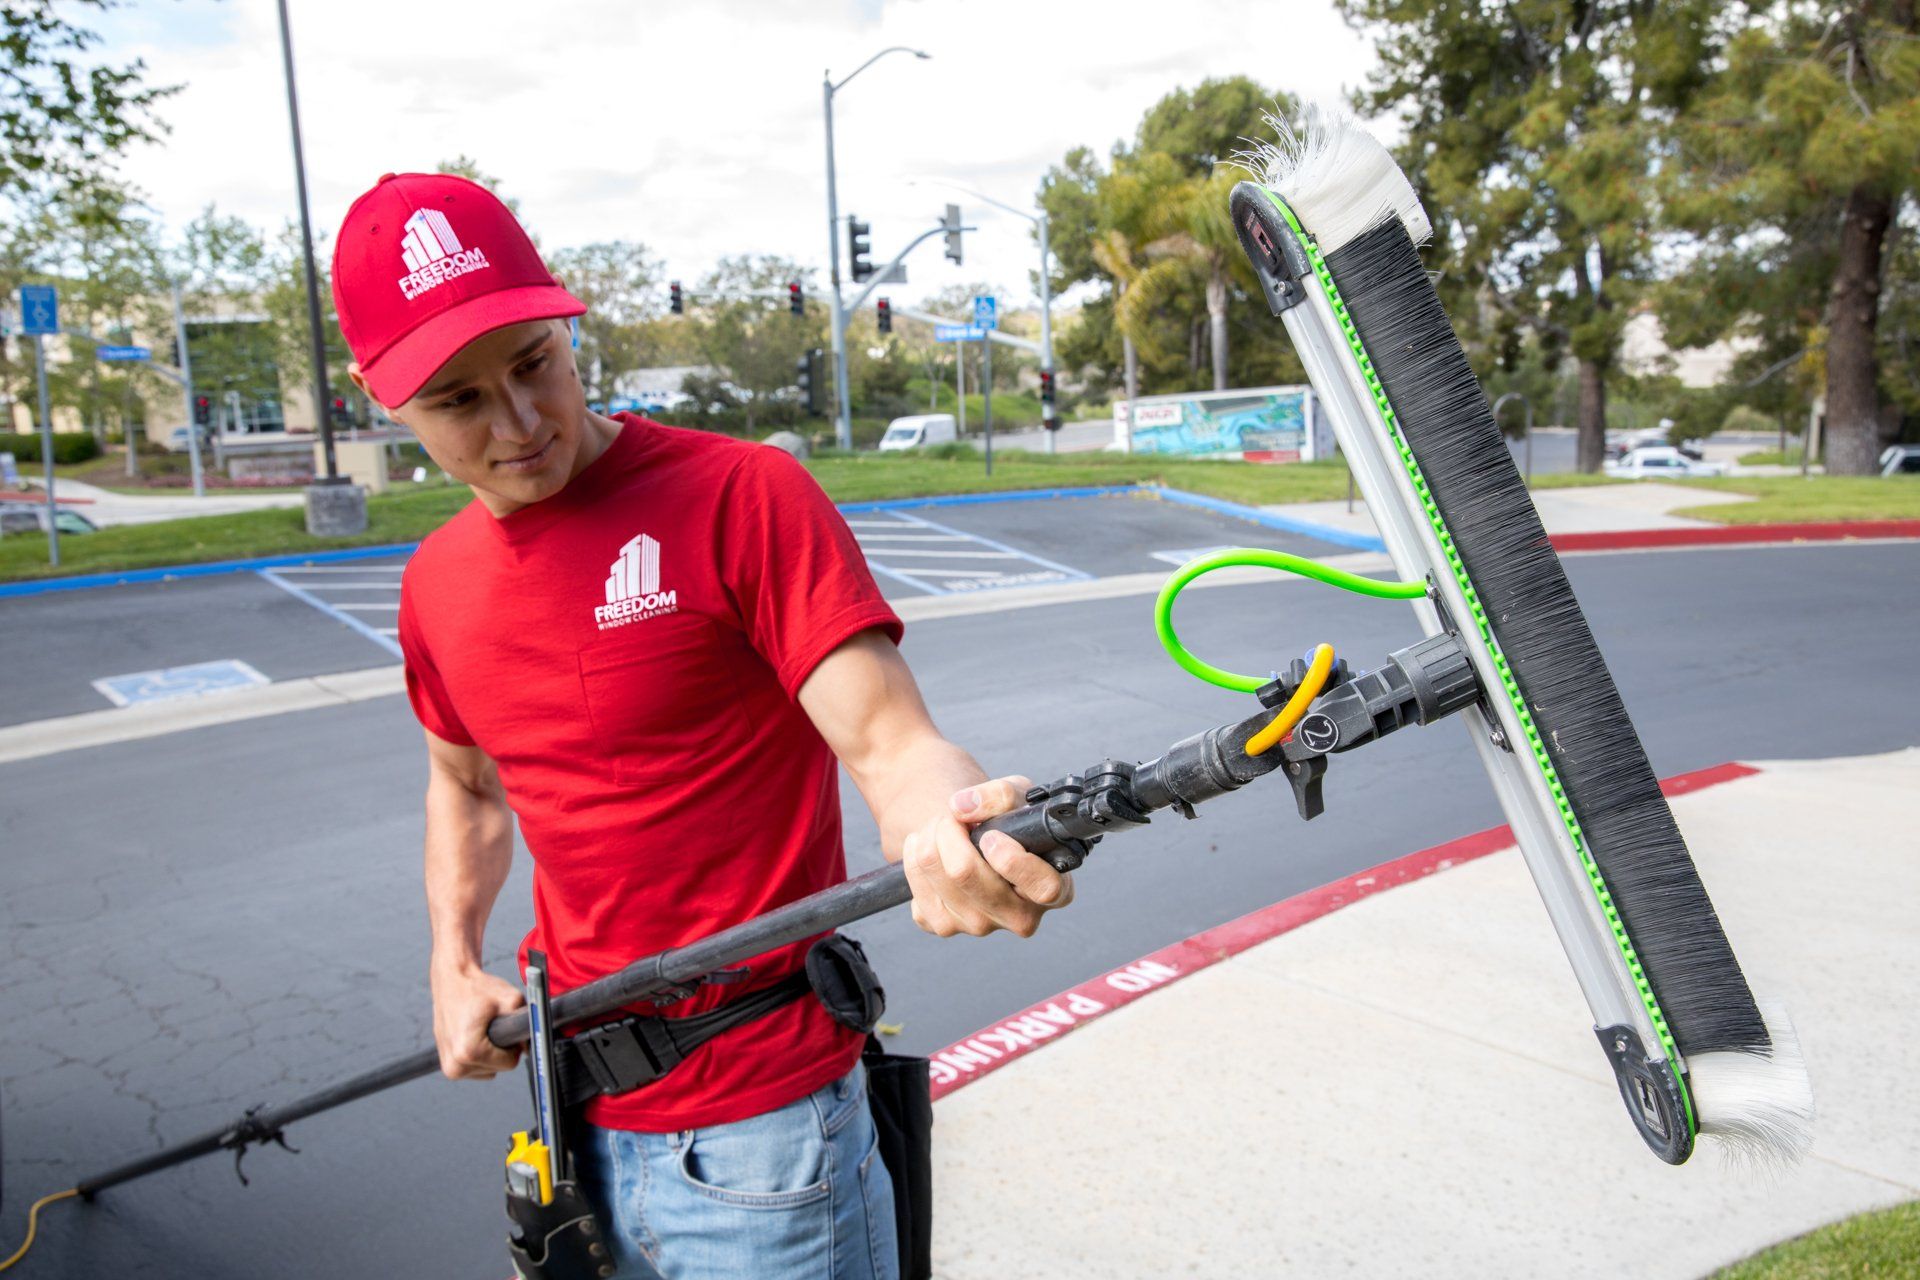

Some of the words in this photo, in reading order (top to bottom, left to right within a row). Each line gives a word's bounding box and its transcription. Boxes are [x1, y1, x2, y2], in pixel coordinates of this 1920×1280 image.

[398, 247, 486, 292] FREEDOM
[404, 274, 444, 300] WINDOW
[444, 261, 490, 280] CLEANING
[594, 590, 677, 622] FREEDOM
[598, 617, 632, 630] WINDOW
[632, 606, 678, 621] CLEANING
[1106, 960, 1178, 992] NO
[929, 993, 1104, 1084] PARKING
